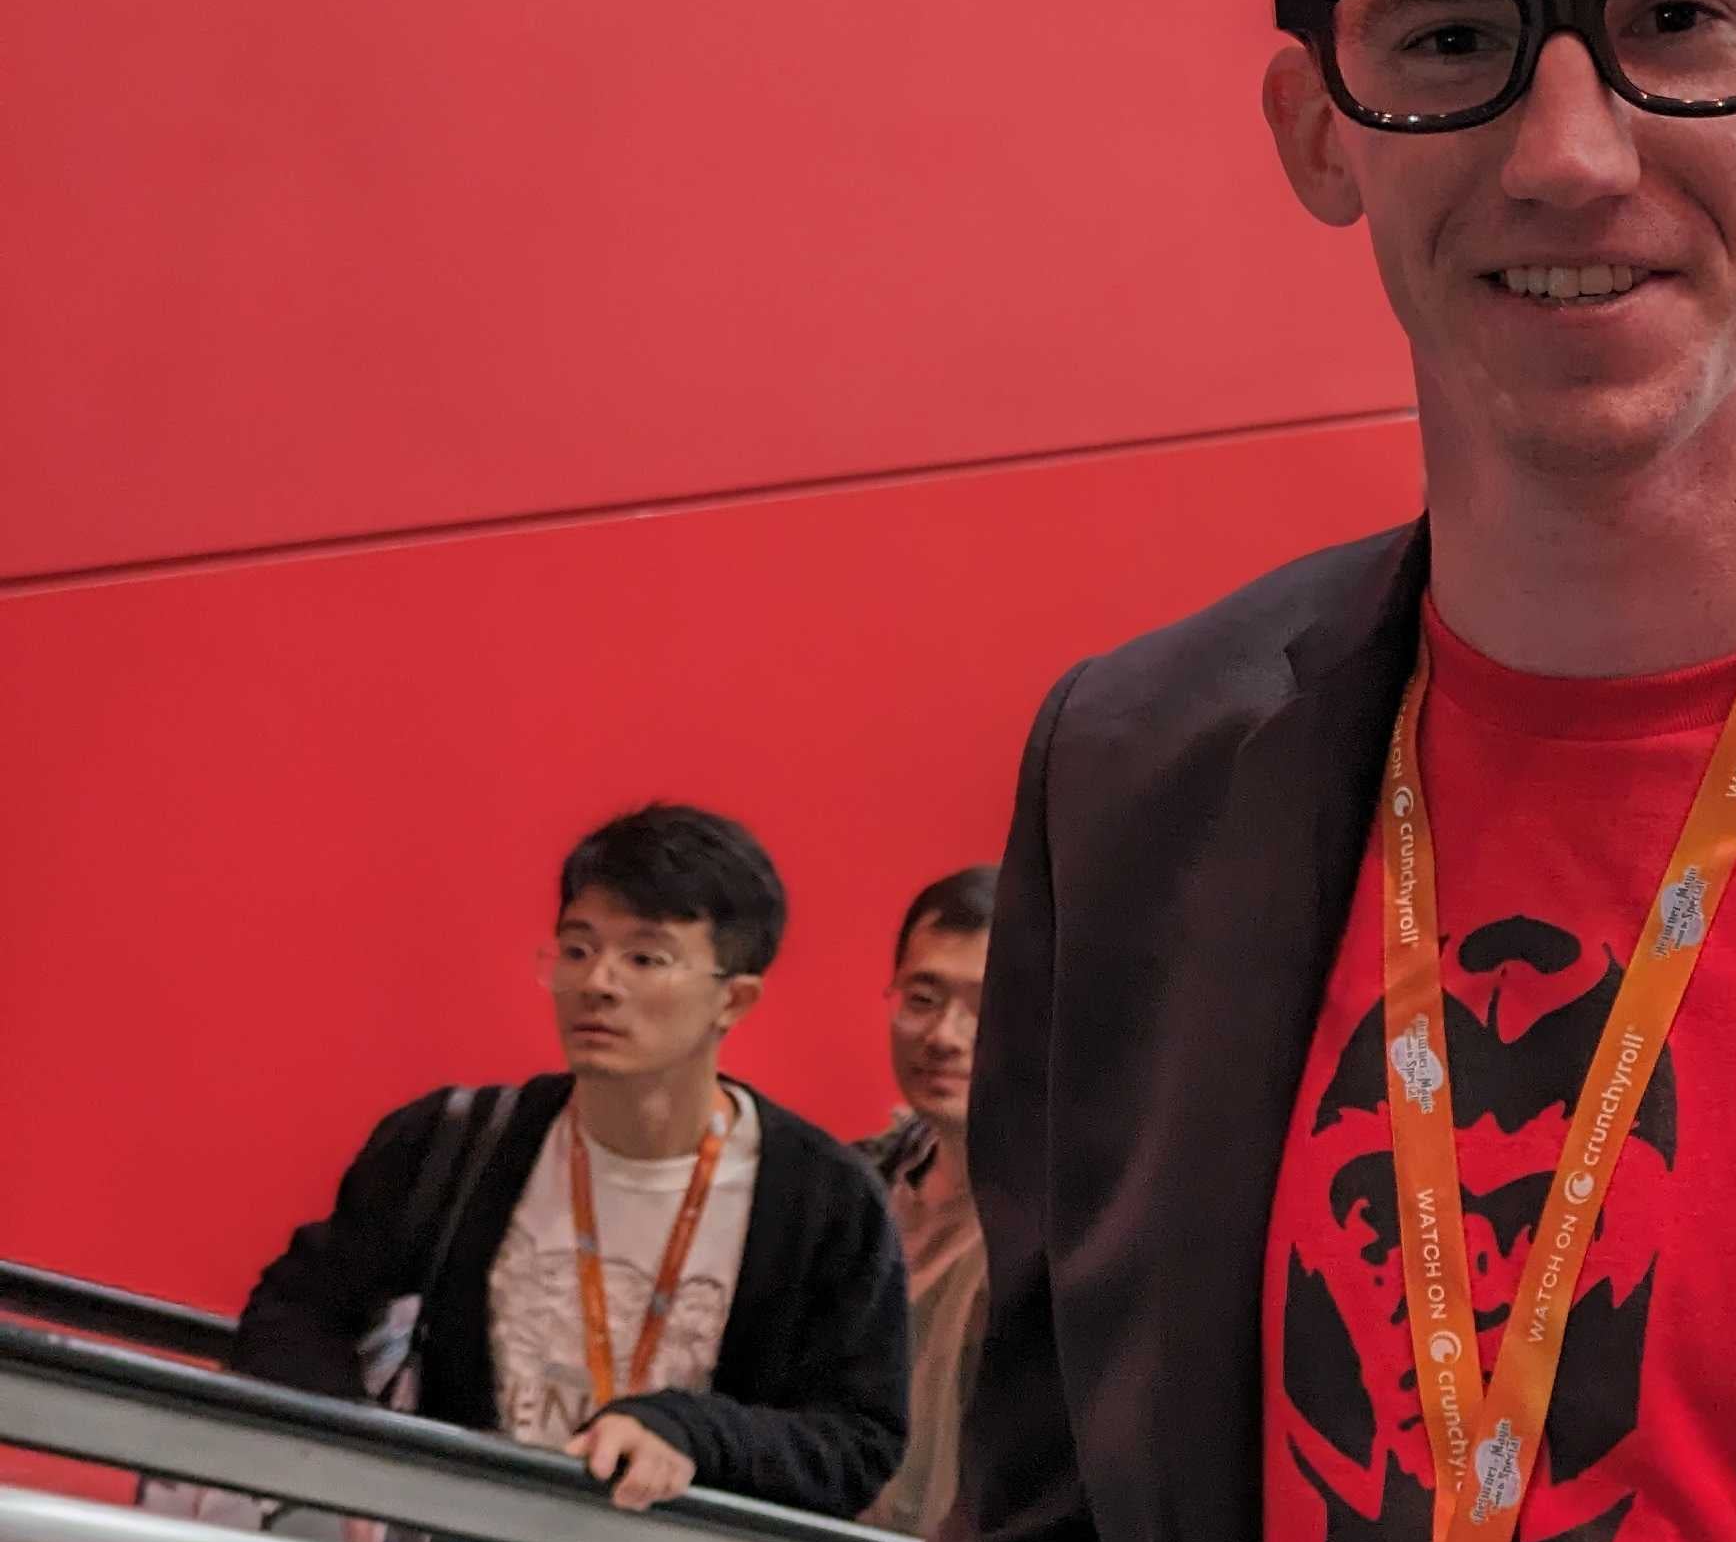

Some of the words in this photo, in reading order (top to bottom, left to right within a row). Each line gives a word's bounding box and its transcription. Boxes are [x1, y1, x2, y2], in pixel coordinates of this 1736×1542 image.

[1396, 821, 1419, 946] crunchyroll
[1415, 1188, 1442, 1278] WATCH
[1528, 1257, 1565, 1344] WATCH
[1555, 1214, 1578, 1248] ON
[1583, 1032, 1646, 1167] crunchyroll
[1428, 1285, 1447, 1321] ON
[1438, 1371, 1470, 1483] crunchy
